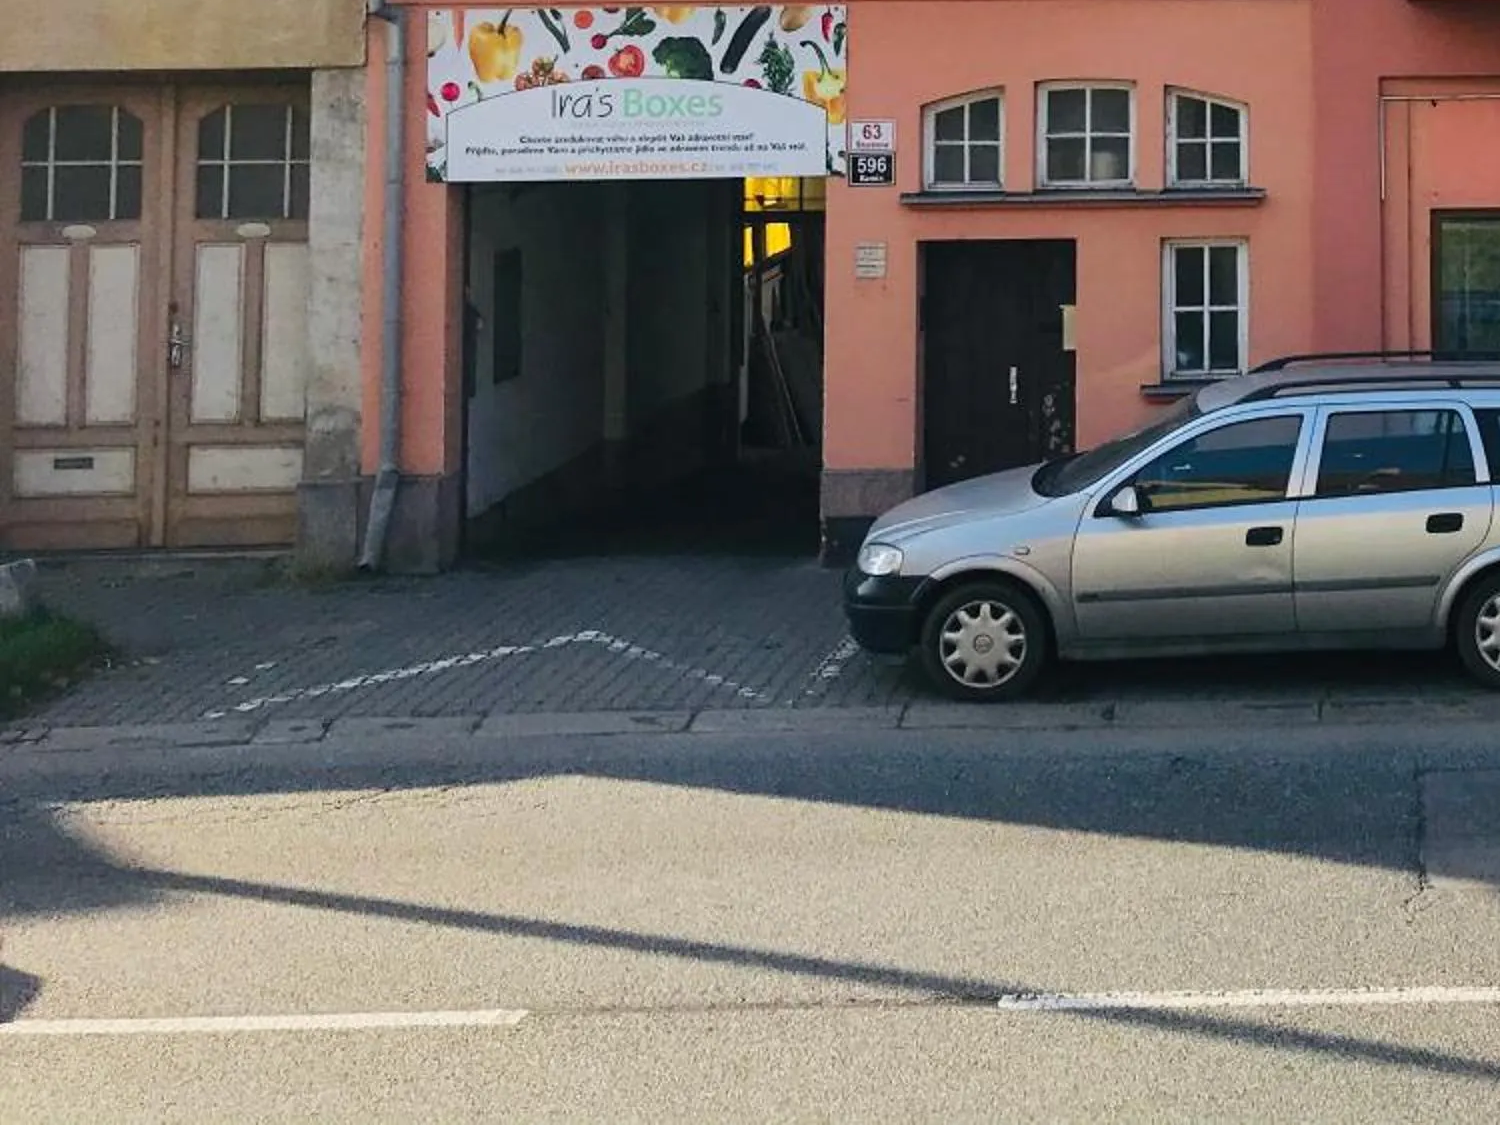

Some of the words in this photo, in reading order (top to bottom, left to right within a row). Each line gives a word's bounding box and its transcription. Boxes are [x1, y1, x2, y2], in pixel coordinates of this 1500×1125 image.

[551, 87, 613, 118] Ira's
[623, 88, 723, 118] Boxes
[863, 124, 882, 140] 63
[565, 159, 707, 174] www.irasboxes.cz
[857, 157, 887, 173] 596
